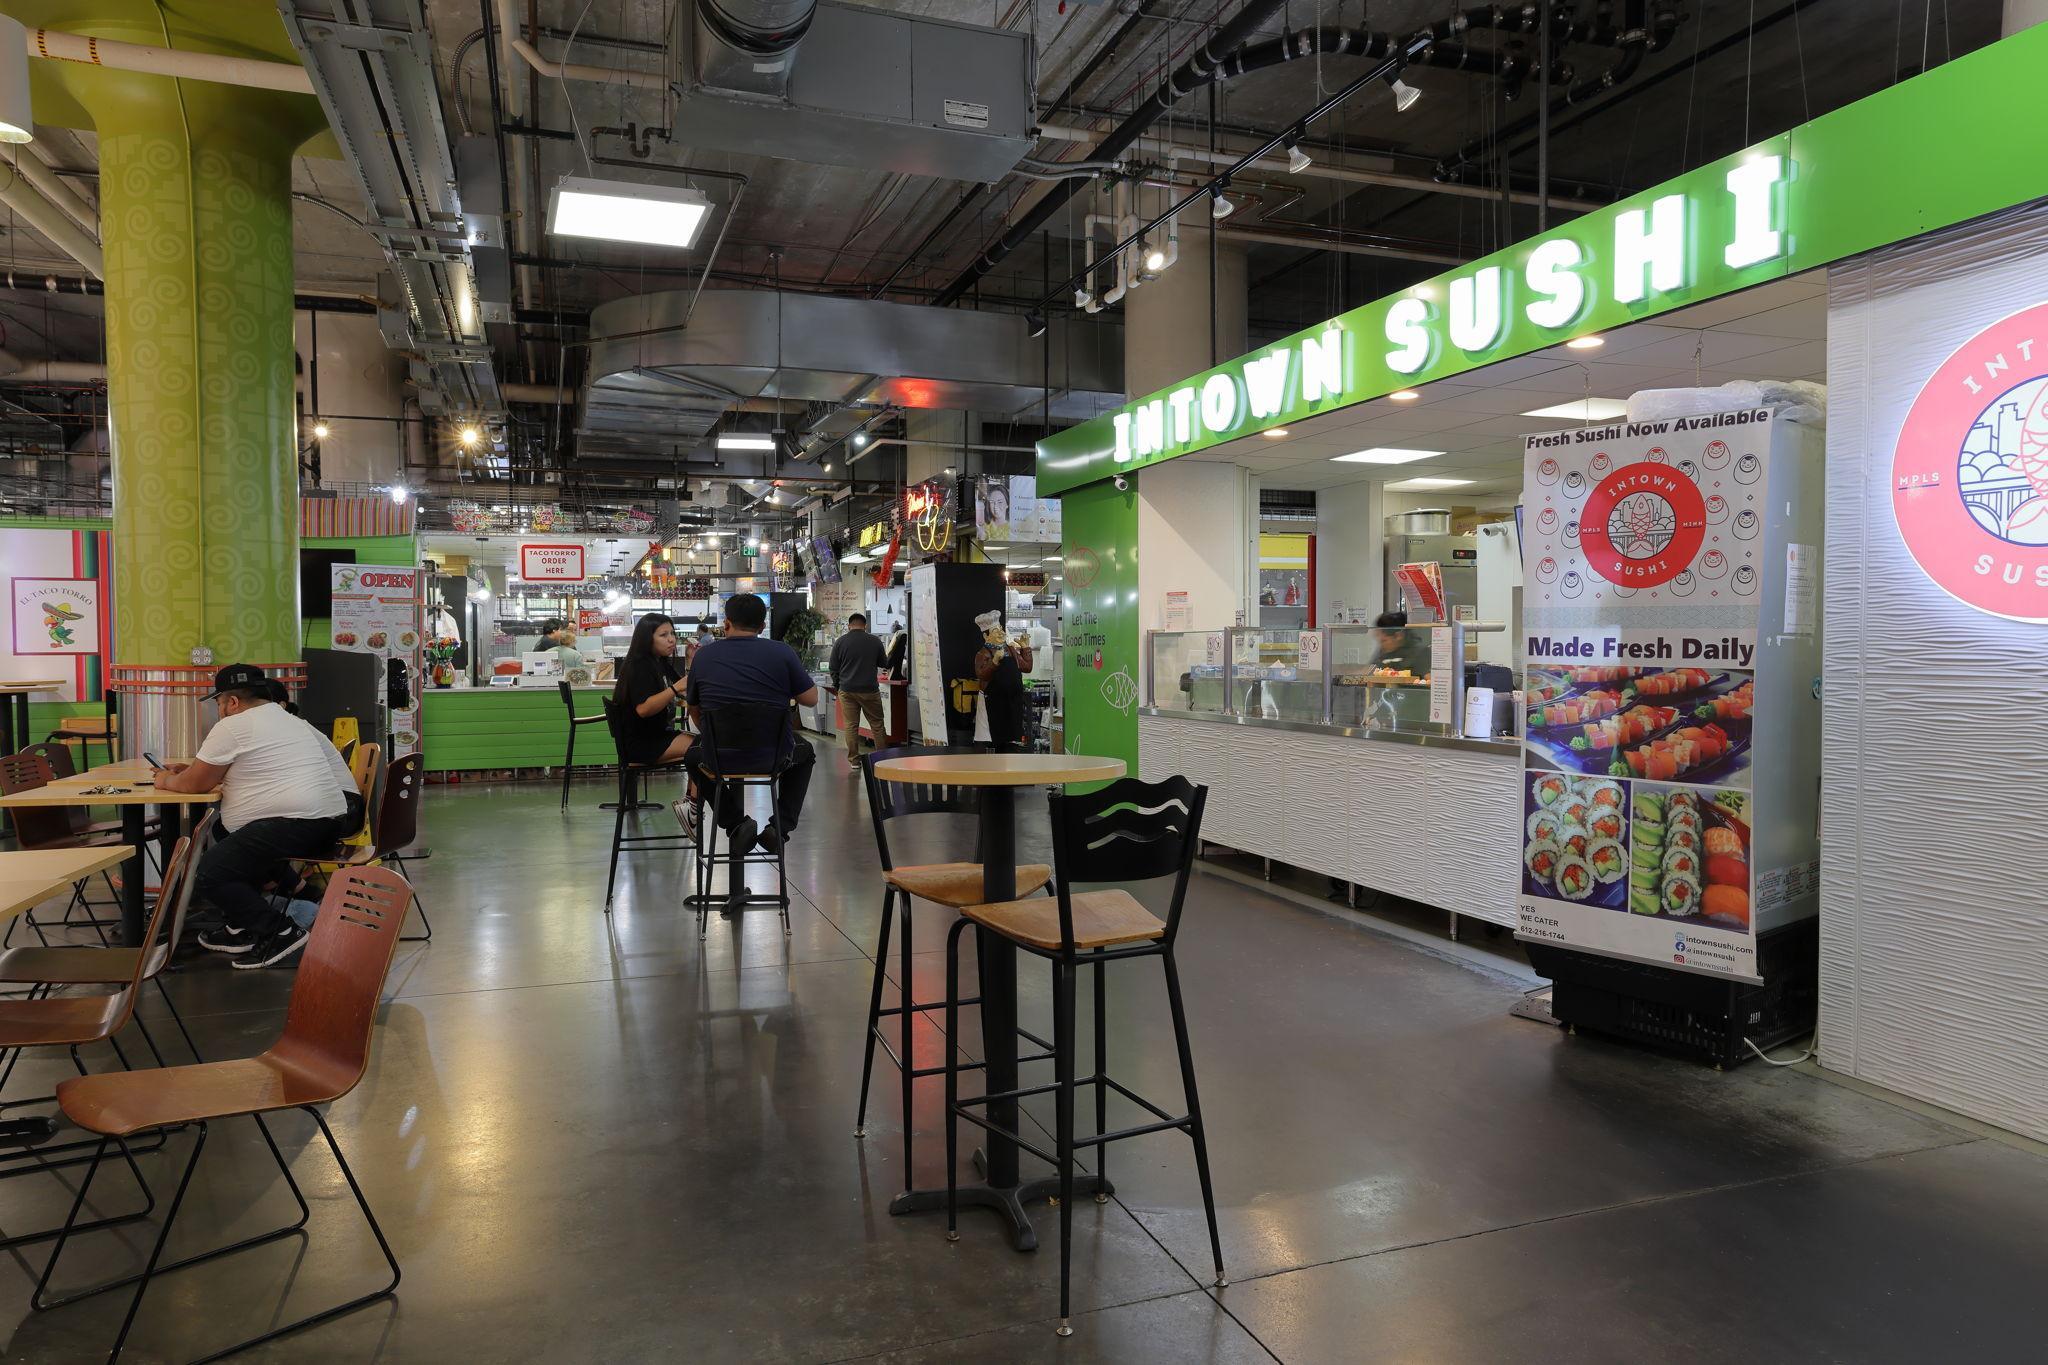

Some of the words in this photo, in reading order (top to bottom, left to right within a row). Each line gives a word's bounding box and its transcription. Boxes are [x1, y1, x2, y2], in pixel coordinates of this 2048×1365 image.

[1112, 328, 1344, 464] INTOWN
[1384, 154, 1783, 375] SUSHI
[1526, 433, 1571, 449] Fresh
[1575, 425, 1621, 444] Sushi
[1626, 421, 1669, 437] Now
[1673, 408, 1769, 432] Available
[1608, 474, 1677, 497] INTOWN
[1899, 472, 1940, 486] MPLS
[541, 557, 567, 565] ORDER
[1613, 560, 1668, 576] SUSHI
[360, 572, 416, 589] OPEN
[31, 587, 59, 598] TACO
[60, 587, 93, 606] TORRO
[581, 614, 608, 625] CLOSING
[1071, 613, 1083, 626] Let
[1084, 611, 1098, 625] The
[1065, 633, 1083, 647] Good
[1084, 632, 1106, 646] Times
[1527, 636, 1595, 658] Made
[1603, 637, 1673, 659] Fresh
[1681, 637, 1755, 667] Daily
[1076, 653, 1093, 668] Roll!
[1520, 904, 1536, 913] YES
[1520, 913, 1533, 922] WE
[1534, 916, 1559, 928] CATER
[1520, 925, 1565, 941] 612-216-1744
[1685, 935, 1754, 955] intownsushi.com
